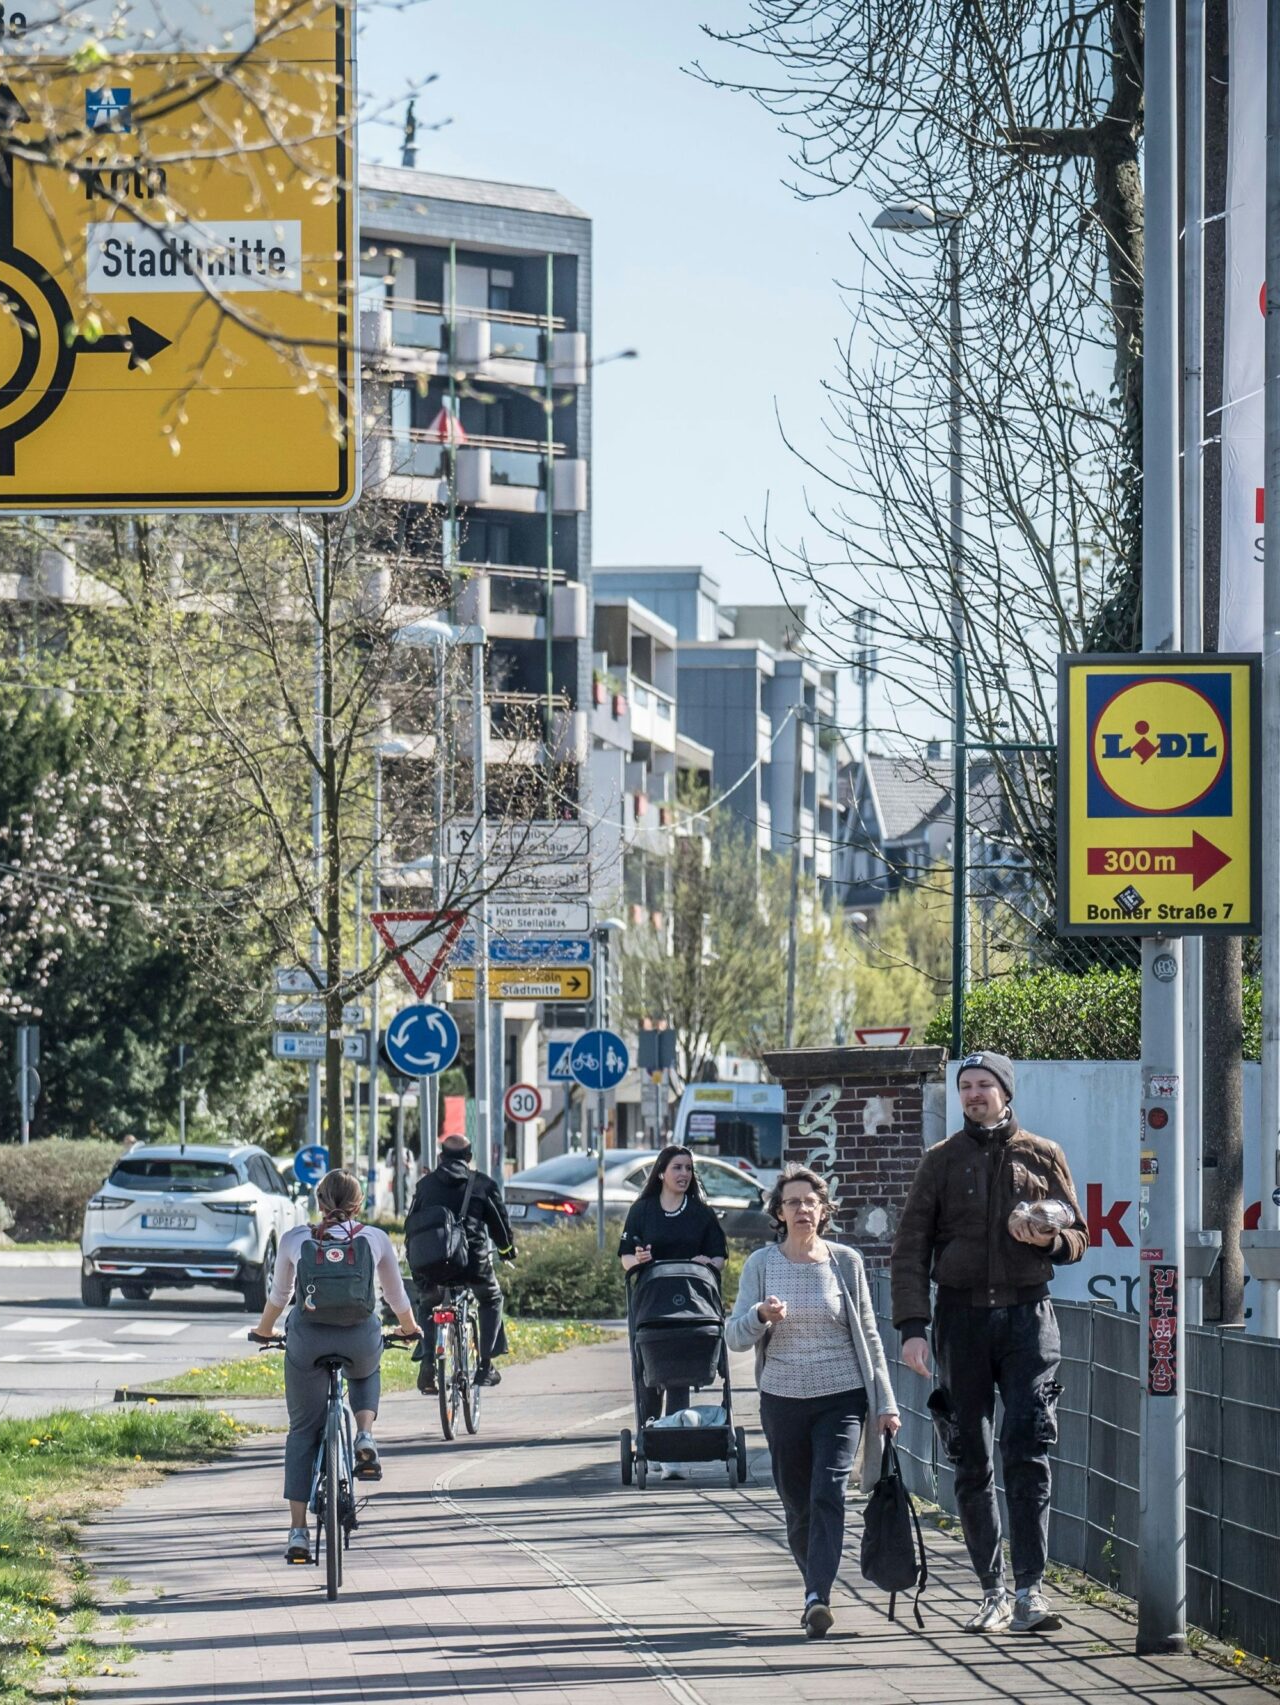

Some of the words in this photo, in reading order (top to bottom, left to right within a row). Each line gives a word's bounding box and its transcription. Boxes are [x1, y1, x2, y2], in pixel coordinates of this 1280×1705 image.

[102, 237, 286, 277] Stadtmitte
[1157, 903, 1217, 920] Straße
[1223, 903, 1233, 919] 7
[502, 986, 560, 995] Stadtmitte
[513, 1094, 534, 1112] 30
